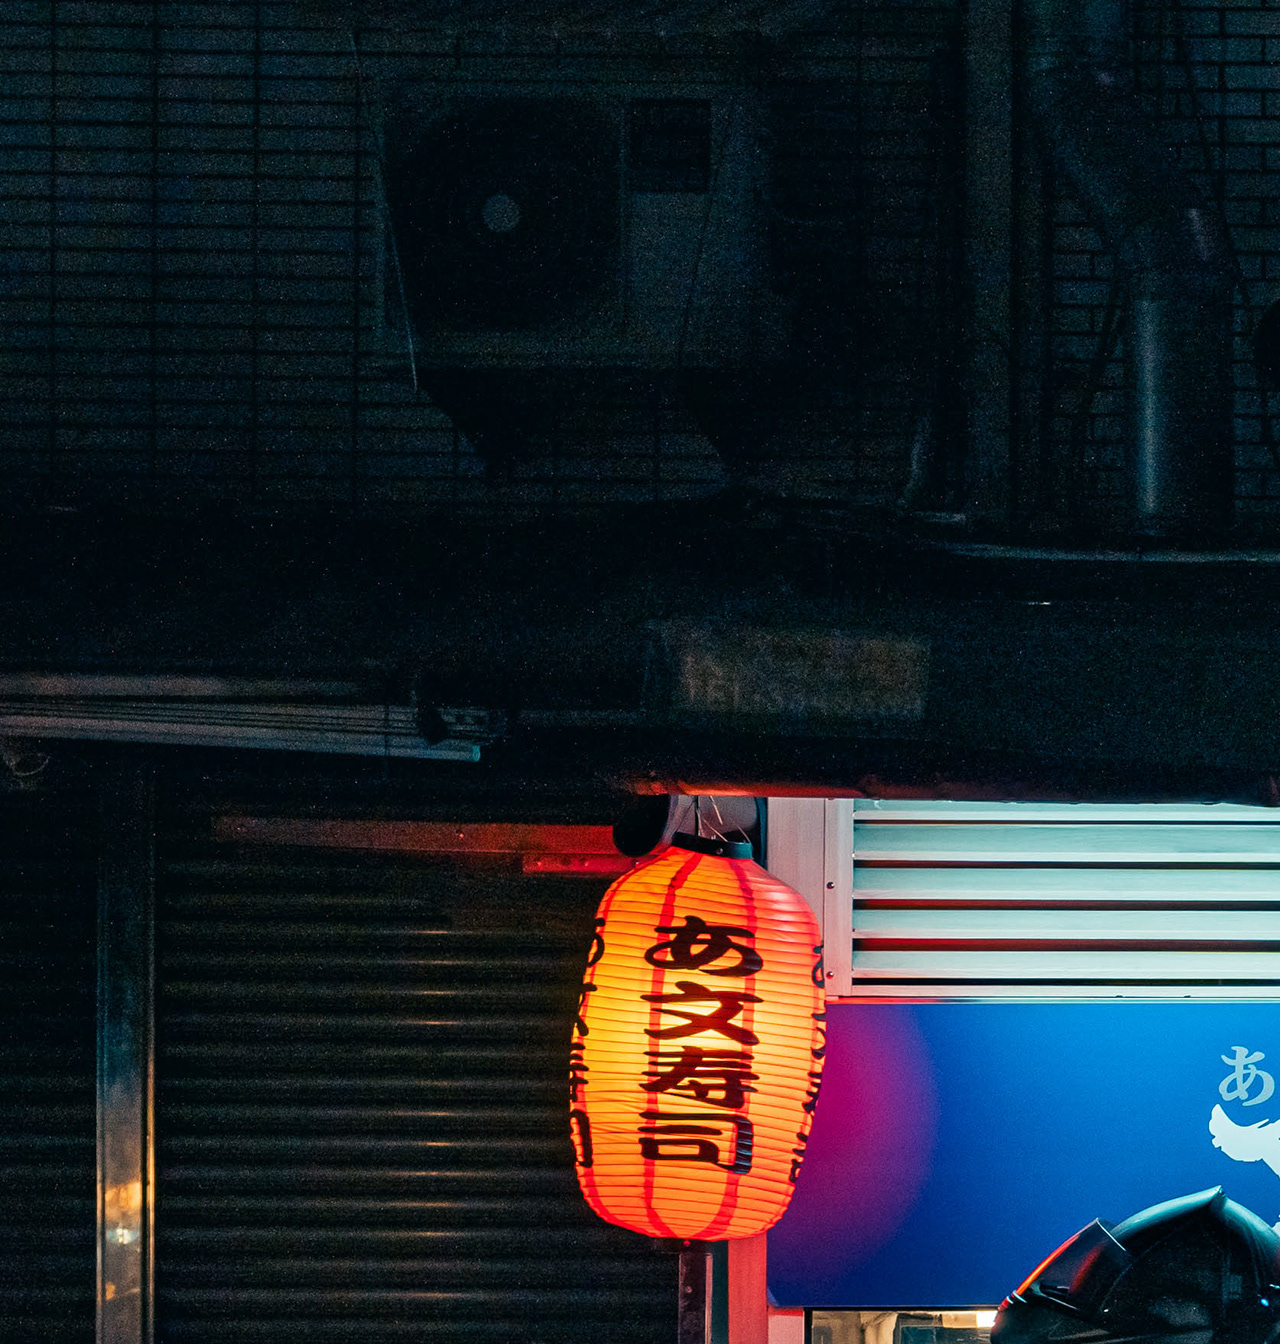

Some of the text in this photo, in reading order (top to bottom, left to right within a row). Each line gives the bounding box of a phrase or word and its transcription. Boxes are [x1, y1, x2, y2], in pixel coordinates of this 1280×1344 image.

[640, 915, 763, 1175] あ文寿司
[1218, 1046, 1275, 1106] あ
